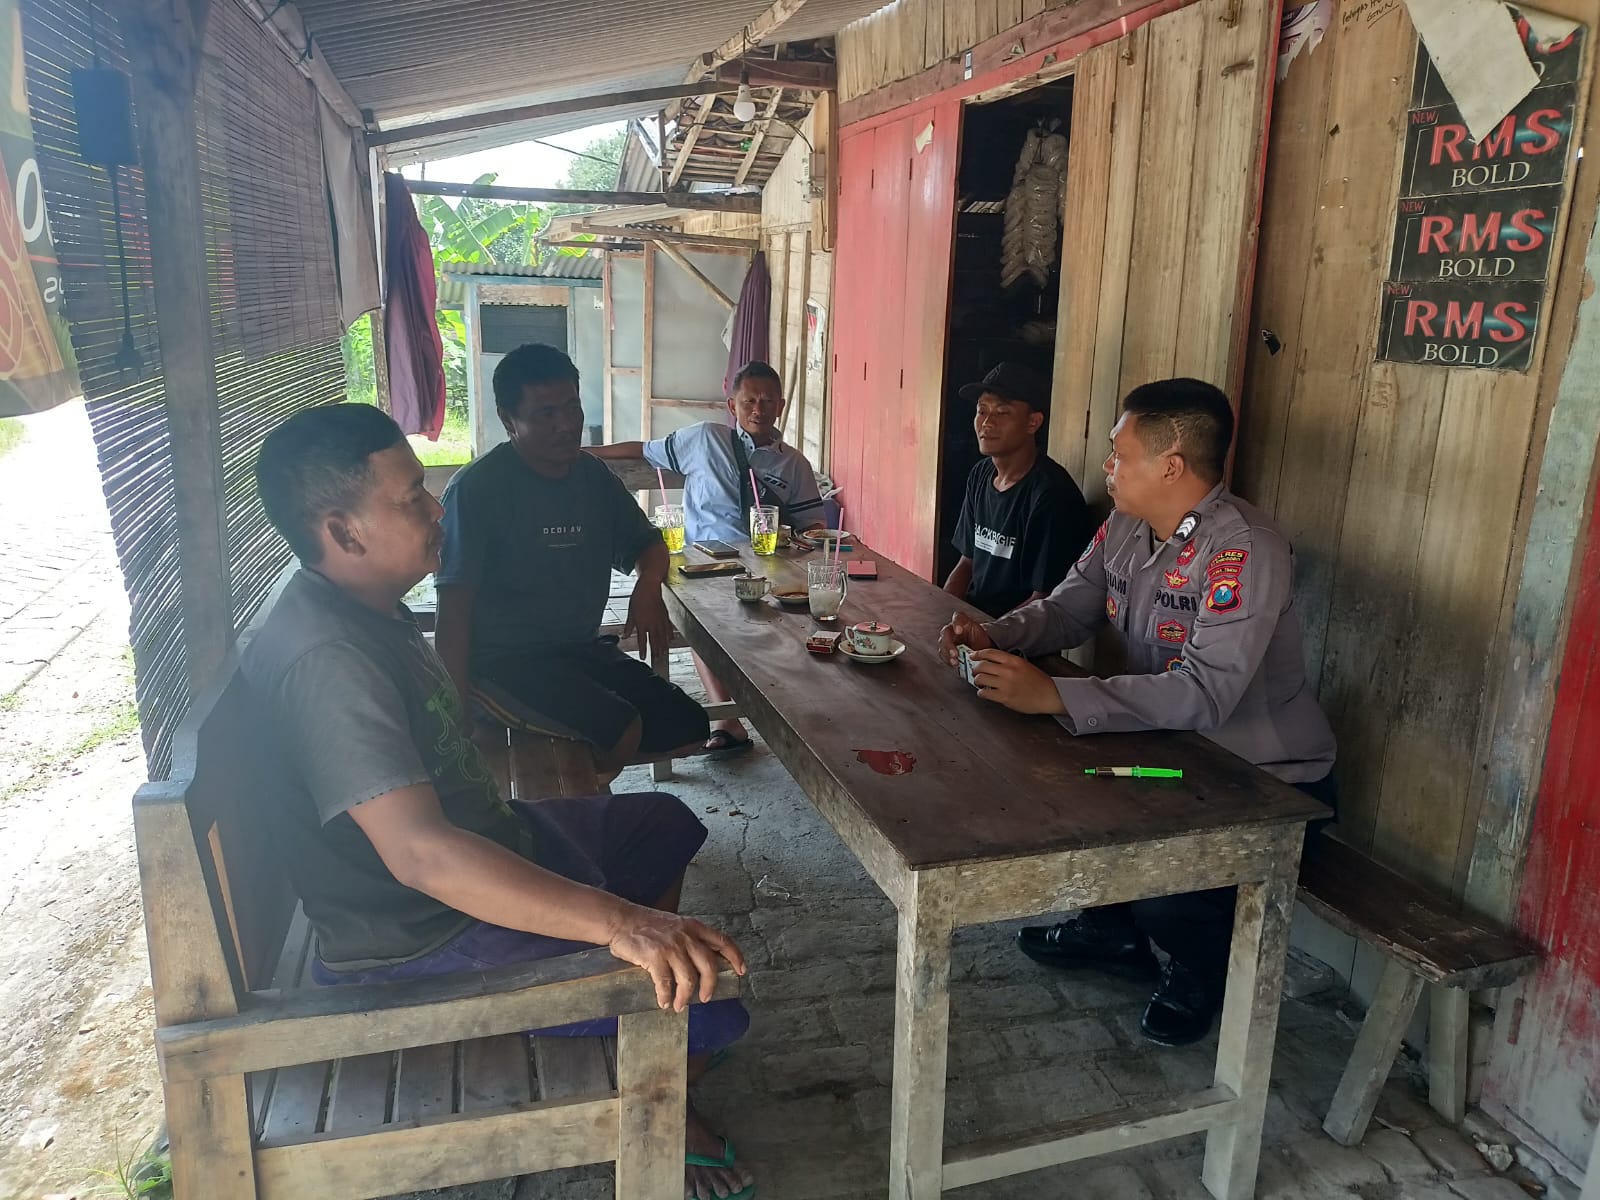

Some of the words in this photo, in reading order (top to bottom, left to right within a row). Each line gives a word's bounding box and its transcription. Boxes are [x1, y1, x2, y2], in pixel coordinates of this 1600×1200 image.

[1411, 112, 1436, 124] NEW
[1429, 108, 1562, 166] RMS
[1451, 161, 1530, 188] BOLD
[1401, 201, 1424, 213] NEW
[1417, 209, 1545, 254] RMS
[1439, 256, 1515, 278] BOLD
[1404, 300, 1528, 343] RMS
[1423, 343, 1499, 365] BOLD
[1154, 589, 1197, 612] POLRI
